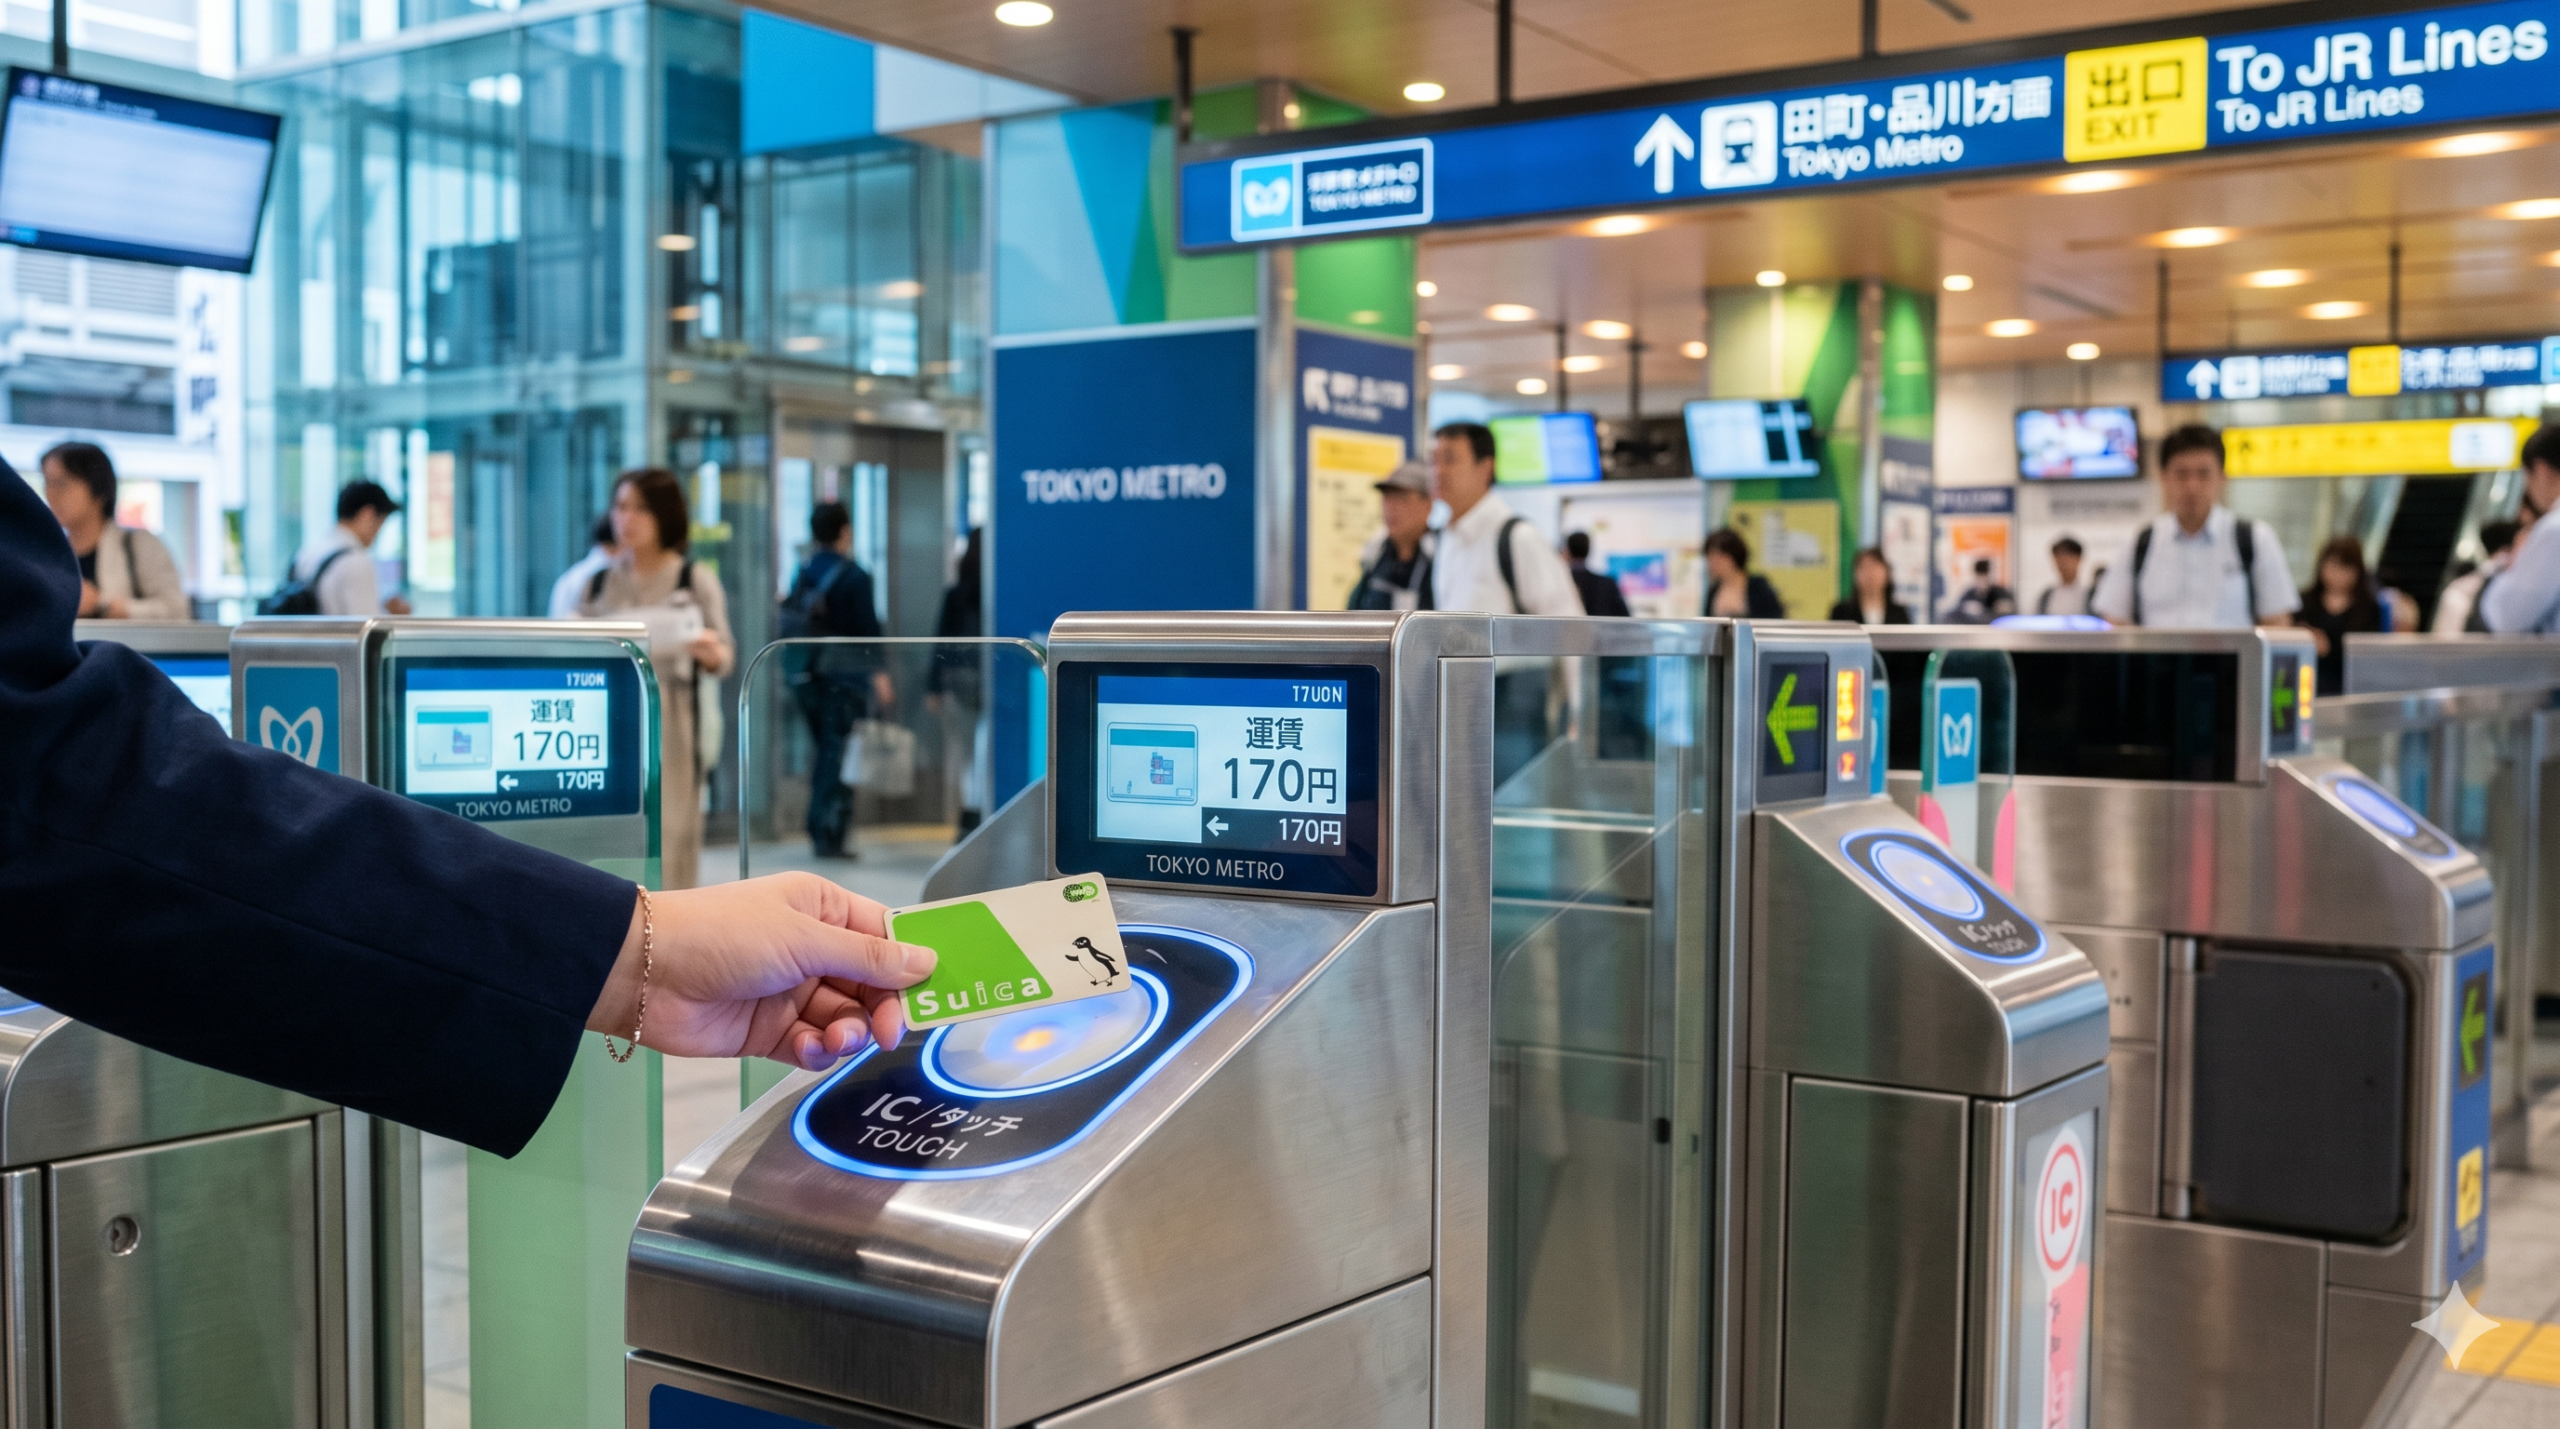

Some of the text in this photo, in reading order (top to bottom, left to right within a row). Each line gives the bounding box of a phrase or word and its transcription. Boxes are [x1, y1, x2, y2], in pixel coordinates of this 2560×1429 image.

[2215, 19, 2549, 95] To JR Lines
[2088, 58, 2184, 109] 出口
[2215, 83, 2425, 134] To JR Lines
[2086, 111, 2159, 144] EXIT
[1782, 133, 1964, 180] Tokyo Metro
[1021, 462, 1227, 504] TOKYO METRO
[530, 698, 575, 723] 運賃
[513, 731, 600, 761] 170円
[1245, 716, 1304, 751] 運賃
[556, 770, 605, 791] 170円
[1223, 757, 1338, 805] 170円
[456, 797, 572, 818] TOKYO METRO
[1278, 817, 1342, 846] 170円
[1146, 854, 1285, 881] TOKYO METRO
[916, 977, 1042, 1016] Suica
[857, 1126, 968, 1159] TOUCH
[2050, 1180, 2073, 1235] IC
